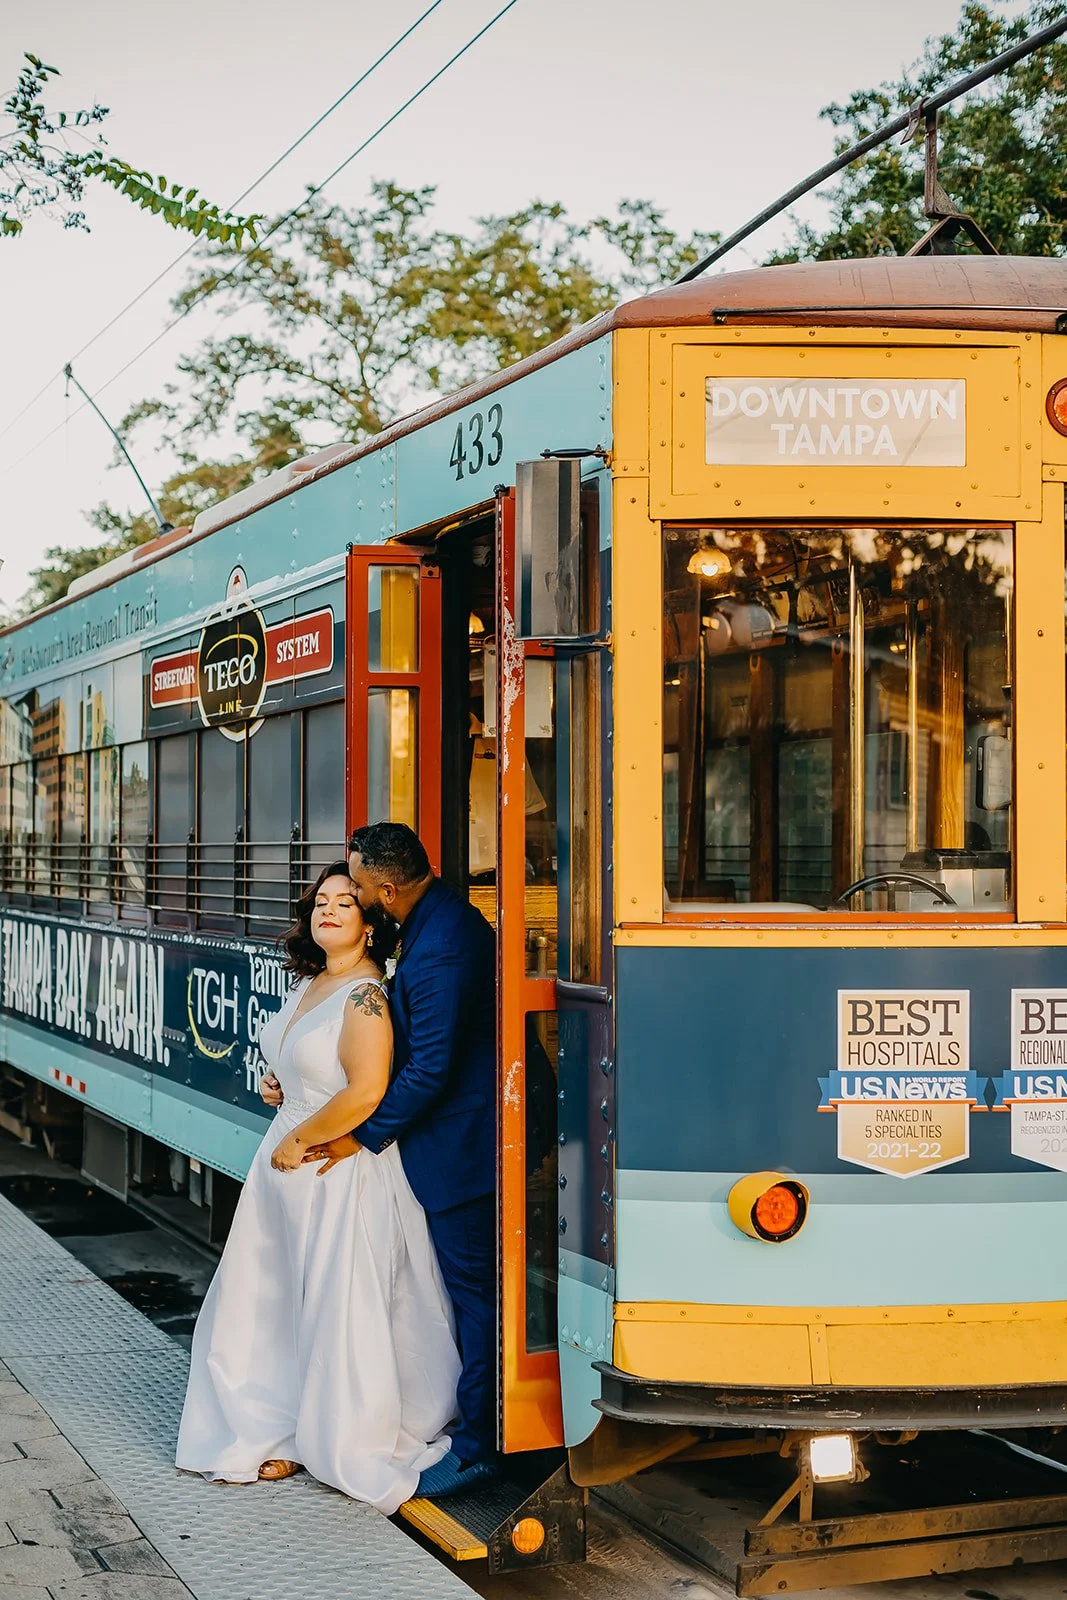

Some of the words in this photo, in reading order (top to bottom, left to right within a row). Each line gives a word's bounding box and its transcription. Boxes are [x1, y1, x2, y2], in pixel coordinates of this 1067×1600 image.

[711, 386, 957, 419] DOWNTOWN
[449, 403, 503, 481] 433
[770, 423, 898, 456] TAMPA
[85, 605, 121, 651] Regional
[125, 592, 158, 635] Transit
[276, 631, 320, 664] SYSTEM
[154, 665, 196, 692] STREETCAR
[204, 654, 256, 692] TECO
[219, 700, 242, 714] LINE
[244, 945, 298, 1007] Tamp
[2, 919, 52, 1023] TAMPA
[55, 928, 91, 1038] BAY.
[96, 936, 170, 1067] AGAIN.
[193, 967, 238, 1034] TGH
[847, 999, 960, 1036] BEST
[1020, 998, 1067, 1035] BE
[847, 1041, 960, 1066] HOSPITALS
[1020, 1040, 1067, 1065] REGIONAL
[865, 1125, 872, 1139] 5
[874, 1125, 942, 1139] SPECIALTIES
[876, 1109, 919, 1122] RANKED
[922, 1109, 932, 1122] IN
[1020, 1126, 1060, 1135] RECOGNIZED
[867, 1142, 942, 1158] 2021-22
